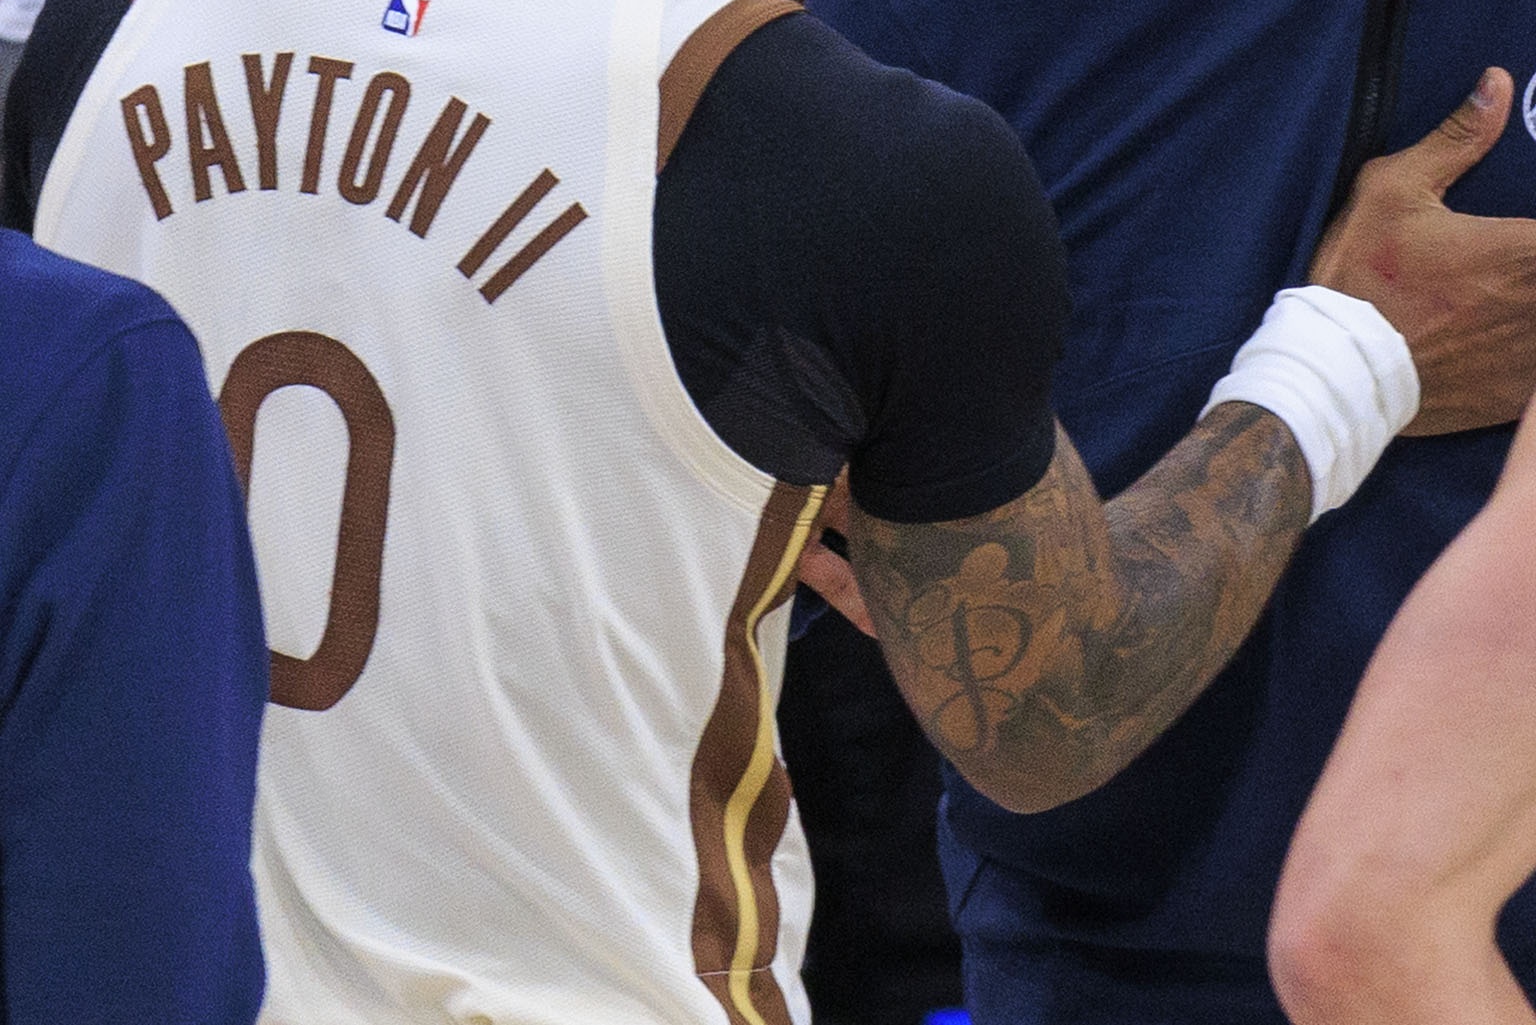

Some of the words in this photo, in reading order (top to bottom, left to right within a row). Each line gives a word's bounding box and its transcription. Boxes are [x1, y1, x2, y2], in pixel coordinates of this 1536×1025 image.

[120, 52, 492, 240] PAYTON
[456, 168, 590, 305] II
[216, 330, 396, 711] 0
